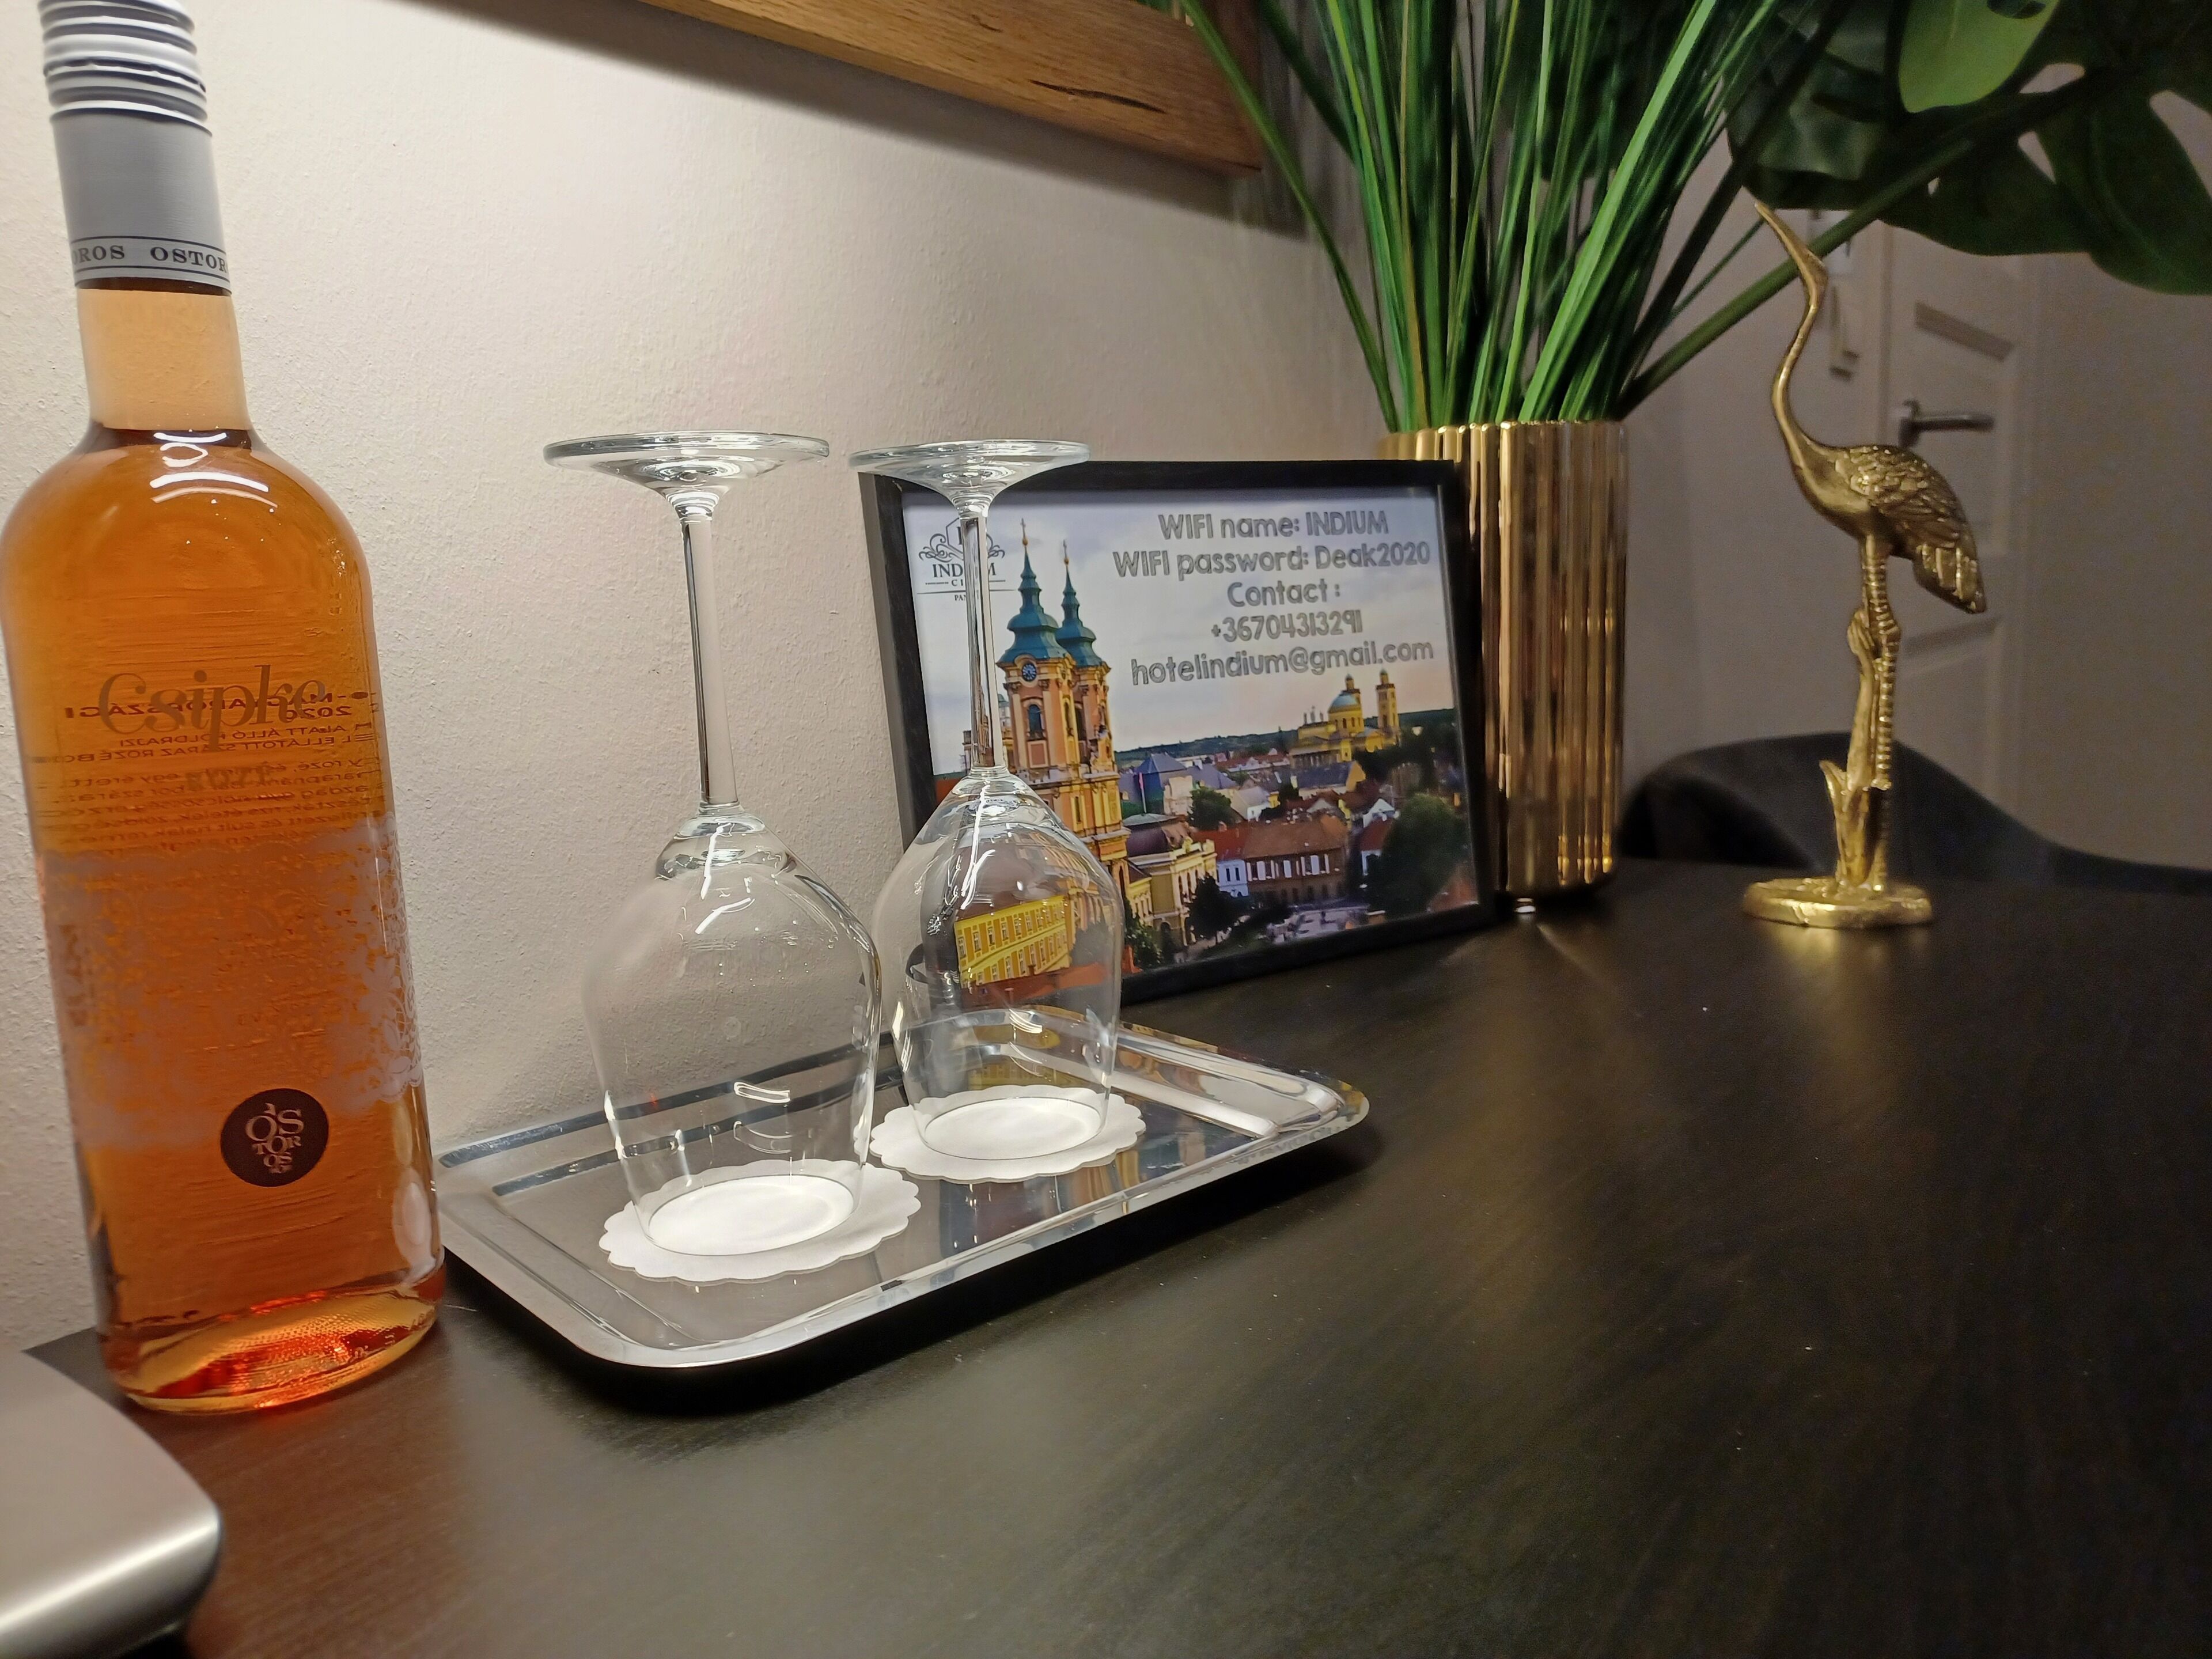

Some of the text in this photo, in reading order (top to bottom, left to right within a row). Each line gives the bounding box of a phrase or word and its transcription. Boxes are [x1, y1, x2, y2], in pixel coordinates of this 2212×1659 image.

[150, 246, 228, 274] OSTOR
[1158, 510, 1389, 540] WIFI name: INDIUM
[932, 562, 997, 578] INDM
[1112, 541, 1430, 581] WIFI password: Deak2020
[1227, 579, 1328, 607] Contact
[1211, 609, 1362, 642] +36704313291
[1131, 641, 1434, 685] hotelindium@gmail.com
[99, 665, 327, 752] Csipke
